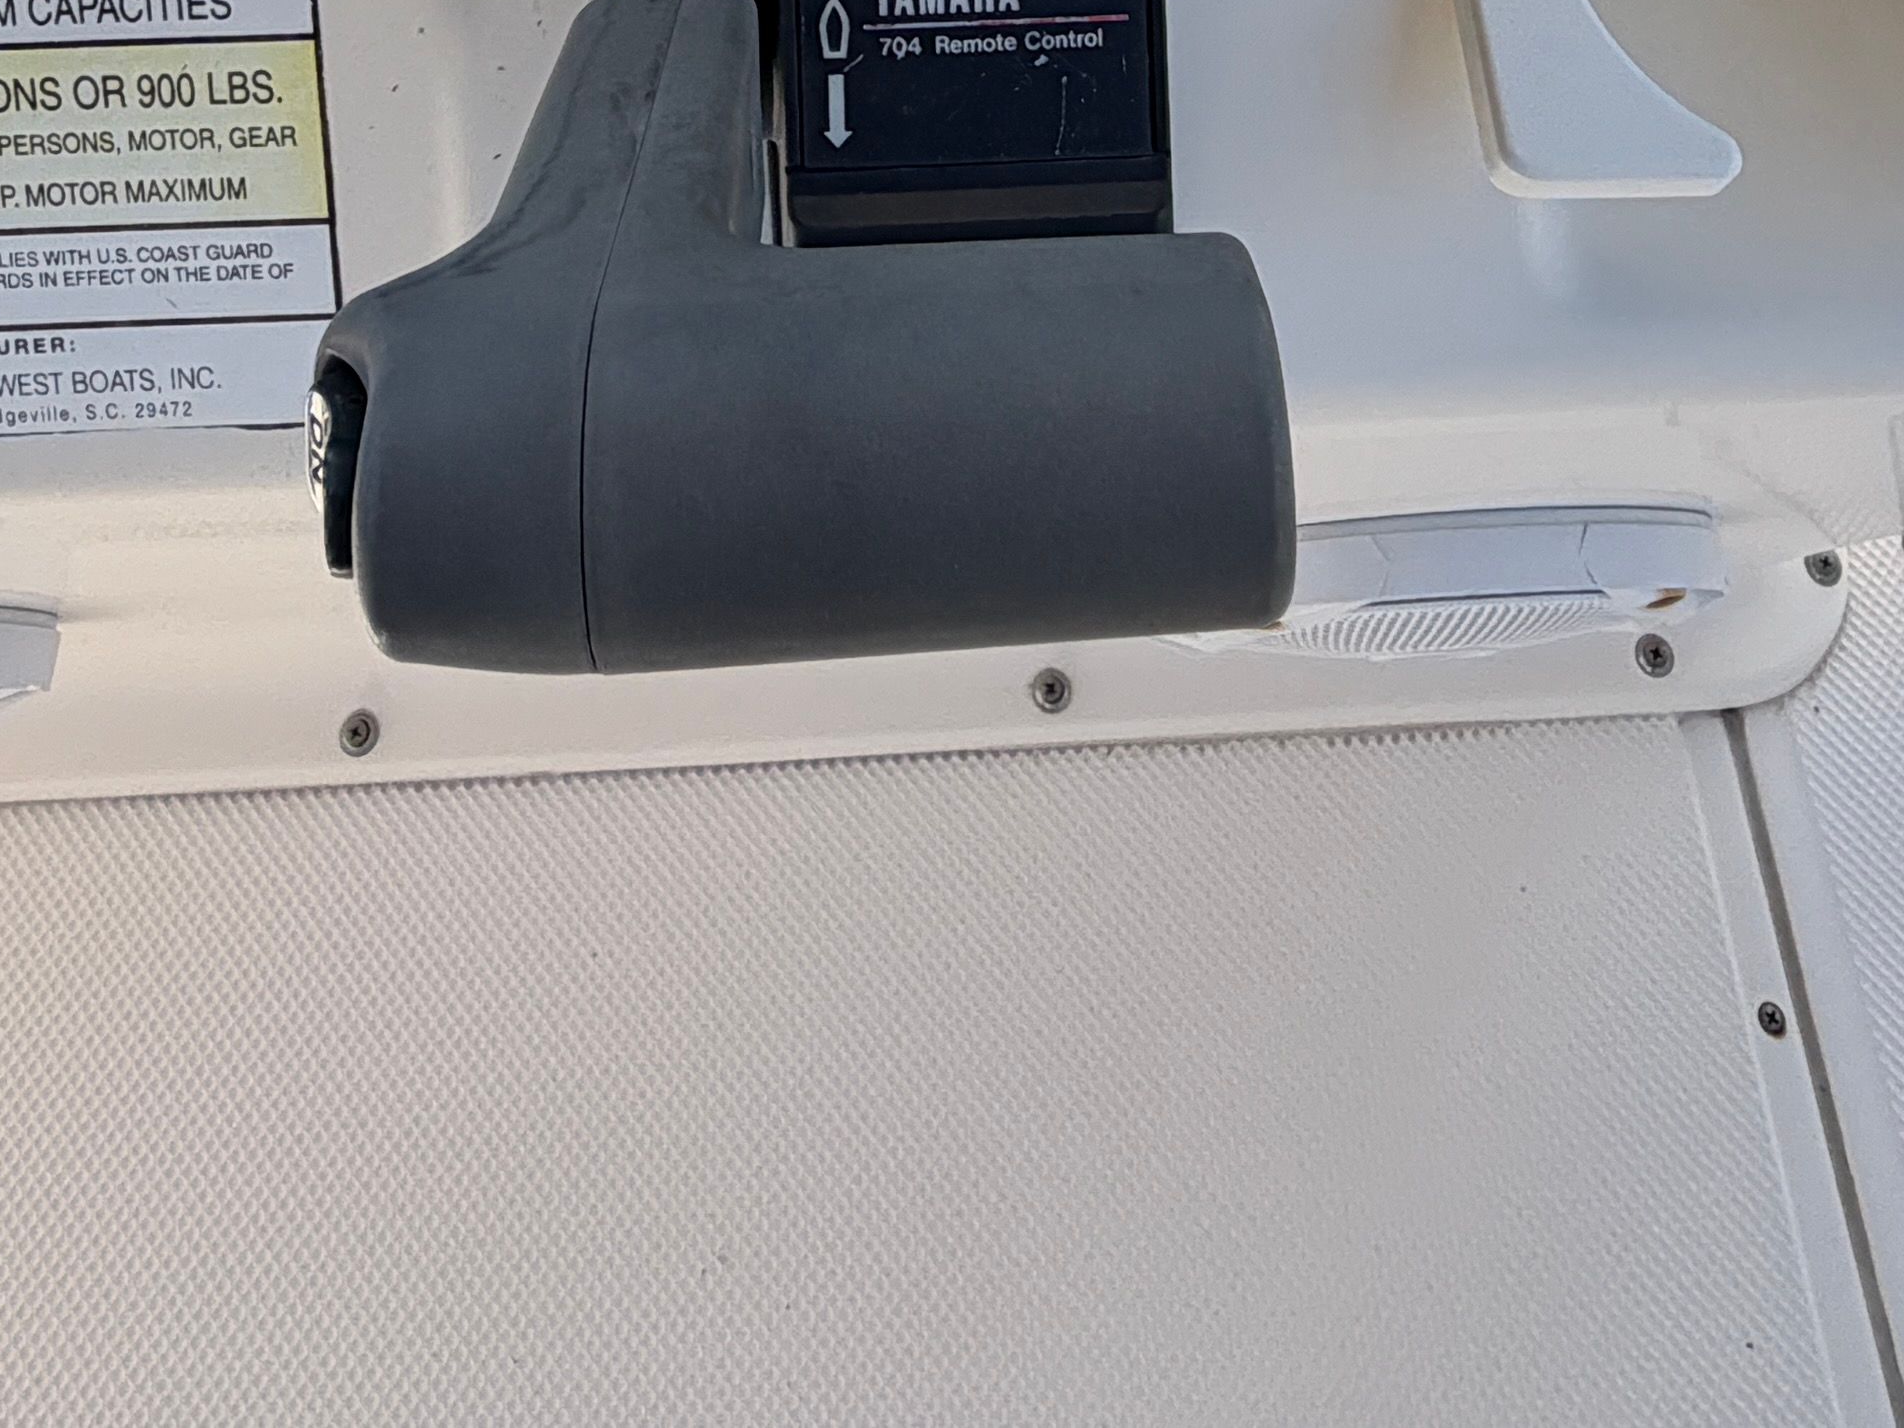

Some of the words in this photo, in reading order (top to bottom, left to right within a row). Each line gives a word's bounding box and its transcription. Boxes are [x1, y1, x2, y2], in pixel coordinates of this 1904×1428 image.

[879, 37, 922, 58] 704
[935, 33, 1017, 55] Remote
[1025, 28, 1104, 50] Control
[72, 75, 128, 110] OR
[136, 73, 196, 108] 900
[206, 69, 284, 106] LBS.
[128, 126, 222, 153] MOTOR,
[228, 124, 298, 149] GEAR
[25, 181, 119, 207] MOTOR
[124, 176, 248, 204] MAXIMUM
[44, 249, 92, 268] WITH
[96, 247, 131, 265] U.S.
[136, 245, 200, 263] COAST
[205, 242, 274, 261] GUARD
[39, 271, 58, 288] IN
[63, 267, 135, 287] EFFECT
[141, 266, 171, 284] ON
[175, 264, 212, 282] THE
[216, 262, 264, 281] DATE
[268, 262, 295, 279] OF
[71, 370, 163, 396] BOATS,
[170, 366, 222, 390] INC.
[85, 405, 127, 421] S.C.
[135, 401, 192, 419] 29472
